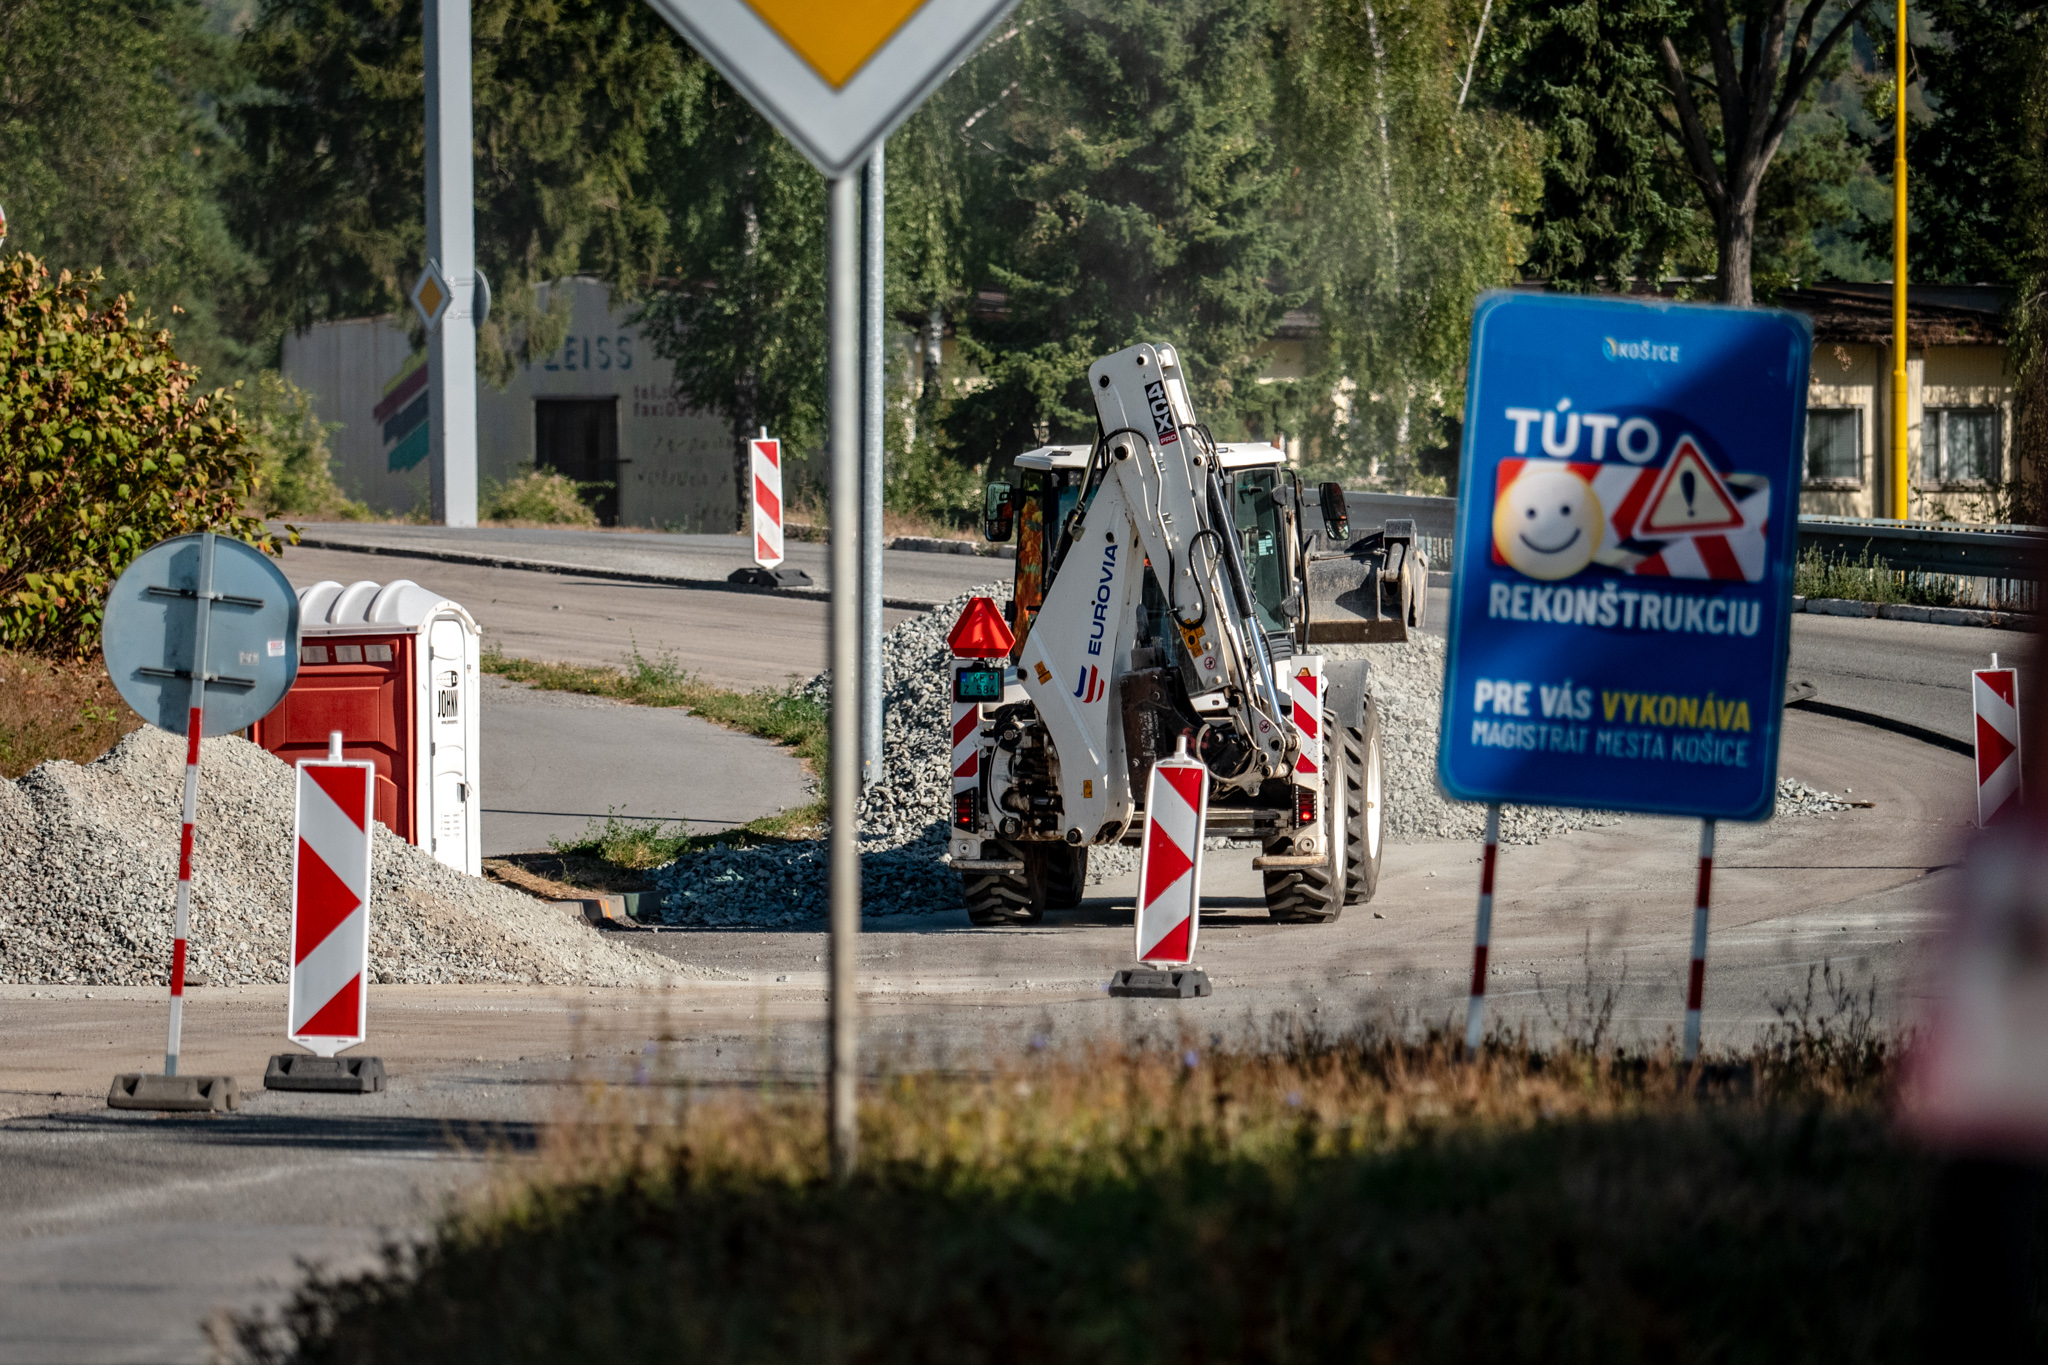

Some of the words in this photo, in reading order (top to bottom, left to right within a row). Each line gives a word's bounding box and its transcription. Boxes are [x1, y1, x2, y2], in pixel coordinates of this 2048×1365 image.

[1619, 339, 1680, 363] KOŠICE
[1148, 382, 1174, 433] 4CX
[1504, 398, 1661, 464] TÚTO
[1160, 434, 1177, 444] PRO
[1087, 544, 1119, 656] EUROVIA
[1488, 581, 1762, 637] REKONŠTRUKCIU
[963, 684, 970, 695] Z
[1472, 678, 1532, 717] PRE
[1538, 680, 1593, 721] VÁS
[1602, 690, 1751, 733] VYKONÁVA
[1470, 719, 1589, 755] MAGISTRÁT
[1595, 729, 1665, 762] MESTA
[1671, 731, 1750, 769] KOŠICE
